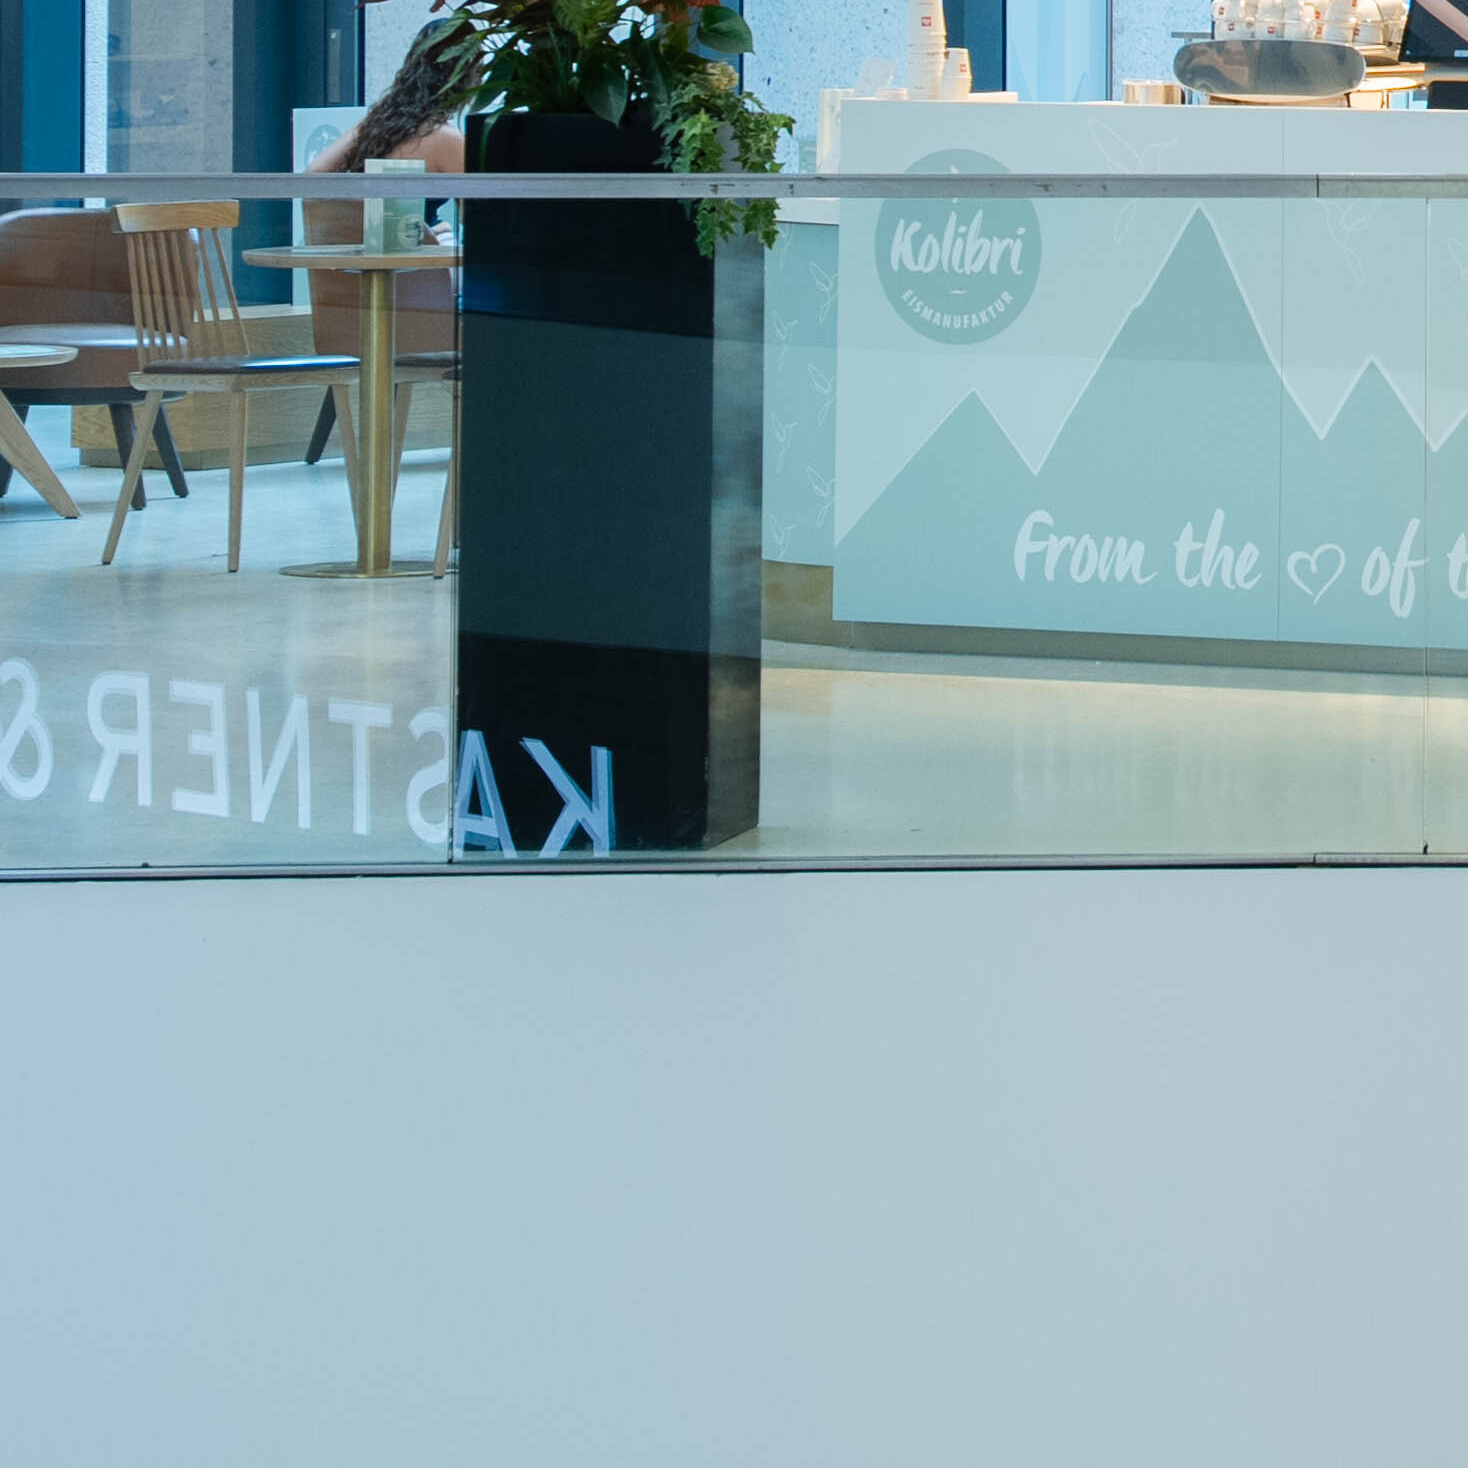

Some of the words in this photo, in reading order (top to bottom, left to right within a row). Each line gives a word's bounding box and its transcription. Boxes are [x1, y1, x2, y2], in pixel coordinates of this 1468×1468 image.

[890, 209, 1027, 275] Kolibri
[901, 288, 1014, 330] EISMANUFAKTUR
[1013, 509, 1159, 585] From
[1174, 508, 1263, 590] the
[1361, 518, 1428, 619] of
